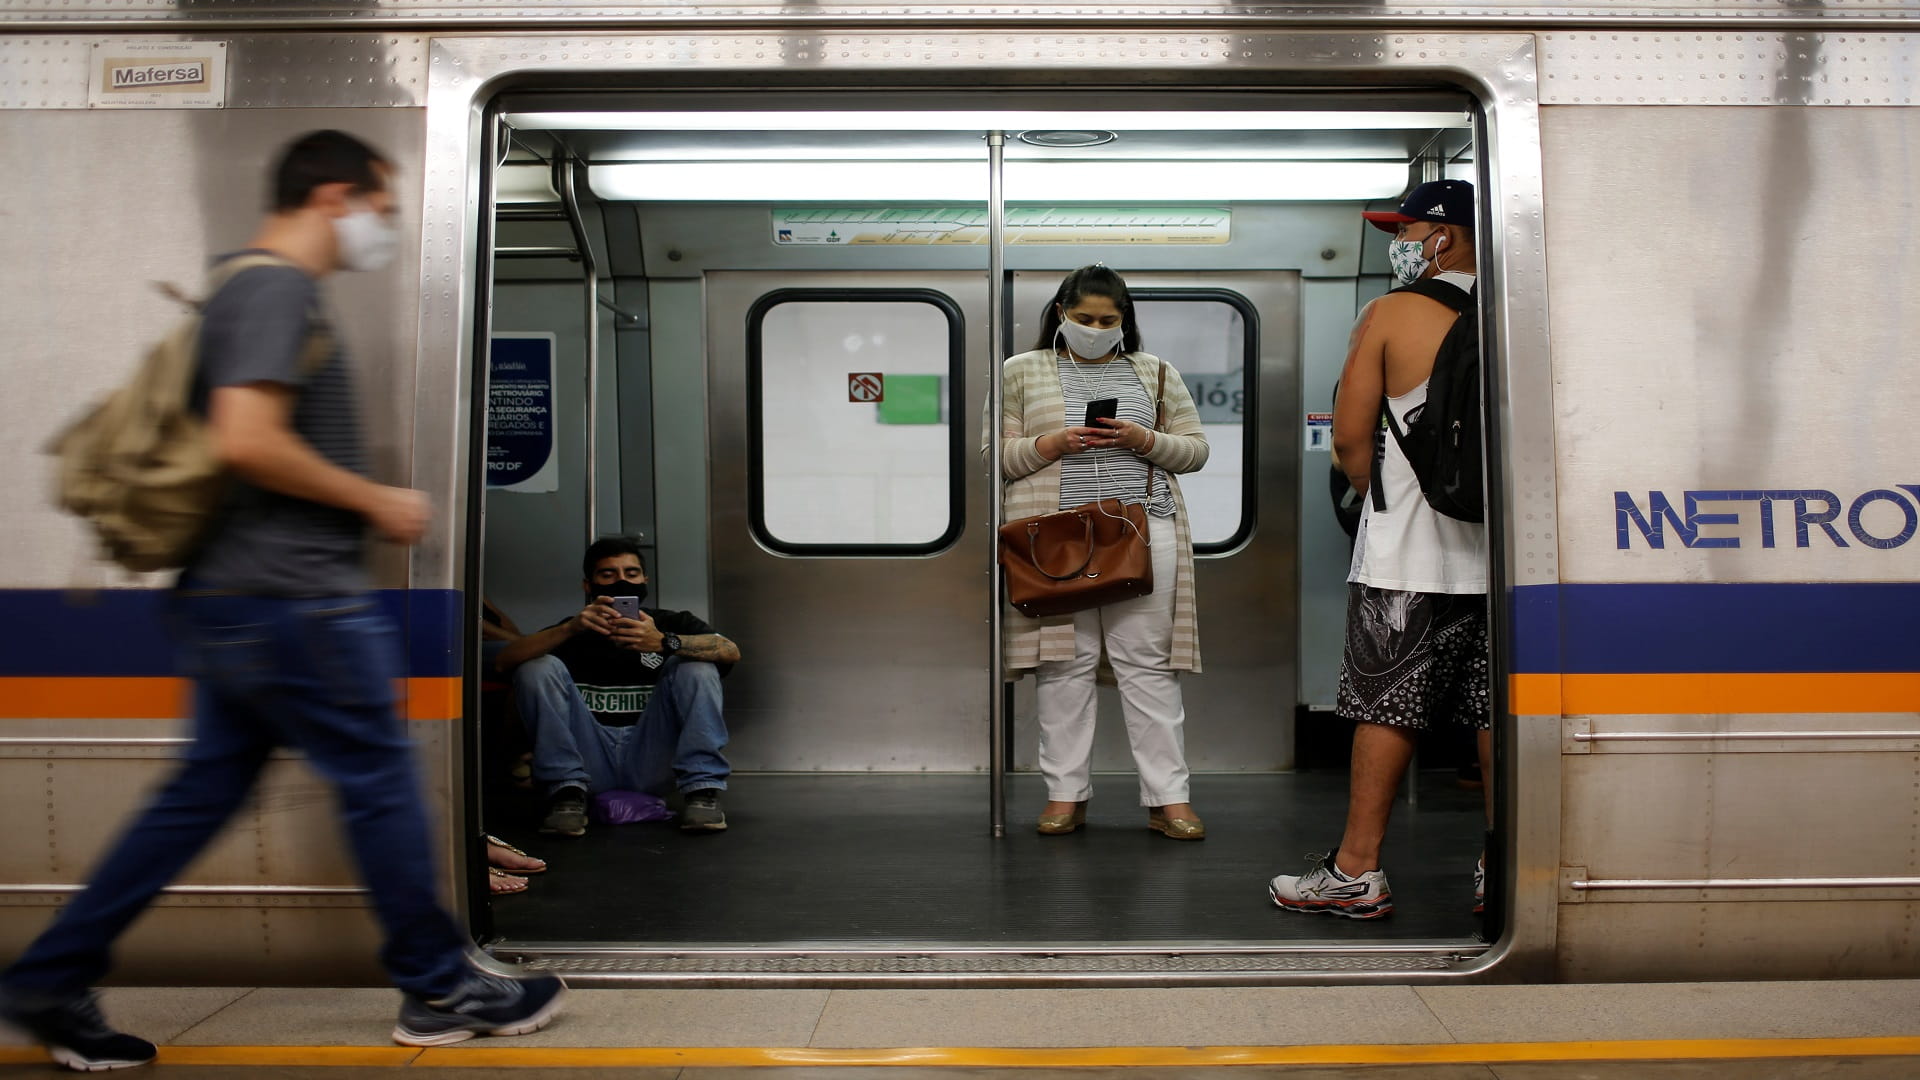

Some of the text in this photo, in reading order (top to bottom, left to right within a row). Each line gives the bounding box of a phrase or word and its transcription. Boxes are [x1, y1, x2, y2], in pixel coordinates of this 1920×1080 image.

[115, 67, 199, 84] Mafersa
[489, 397, 534, 406] NTINDO
[1197, 381, 1244, 415] lóg
[495, 406, 547, 415] SEGURANÇA
[539, 421, 545, 429] E
[506, 461, 522, 470] DF
[582, 690, 652, 713] ASCHIB
